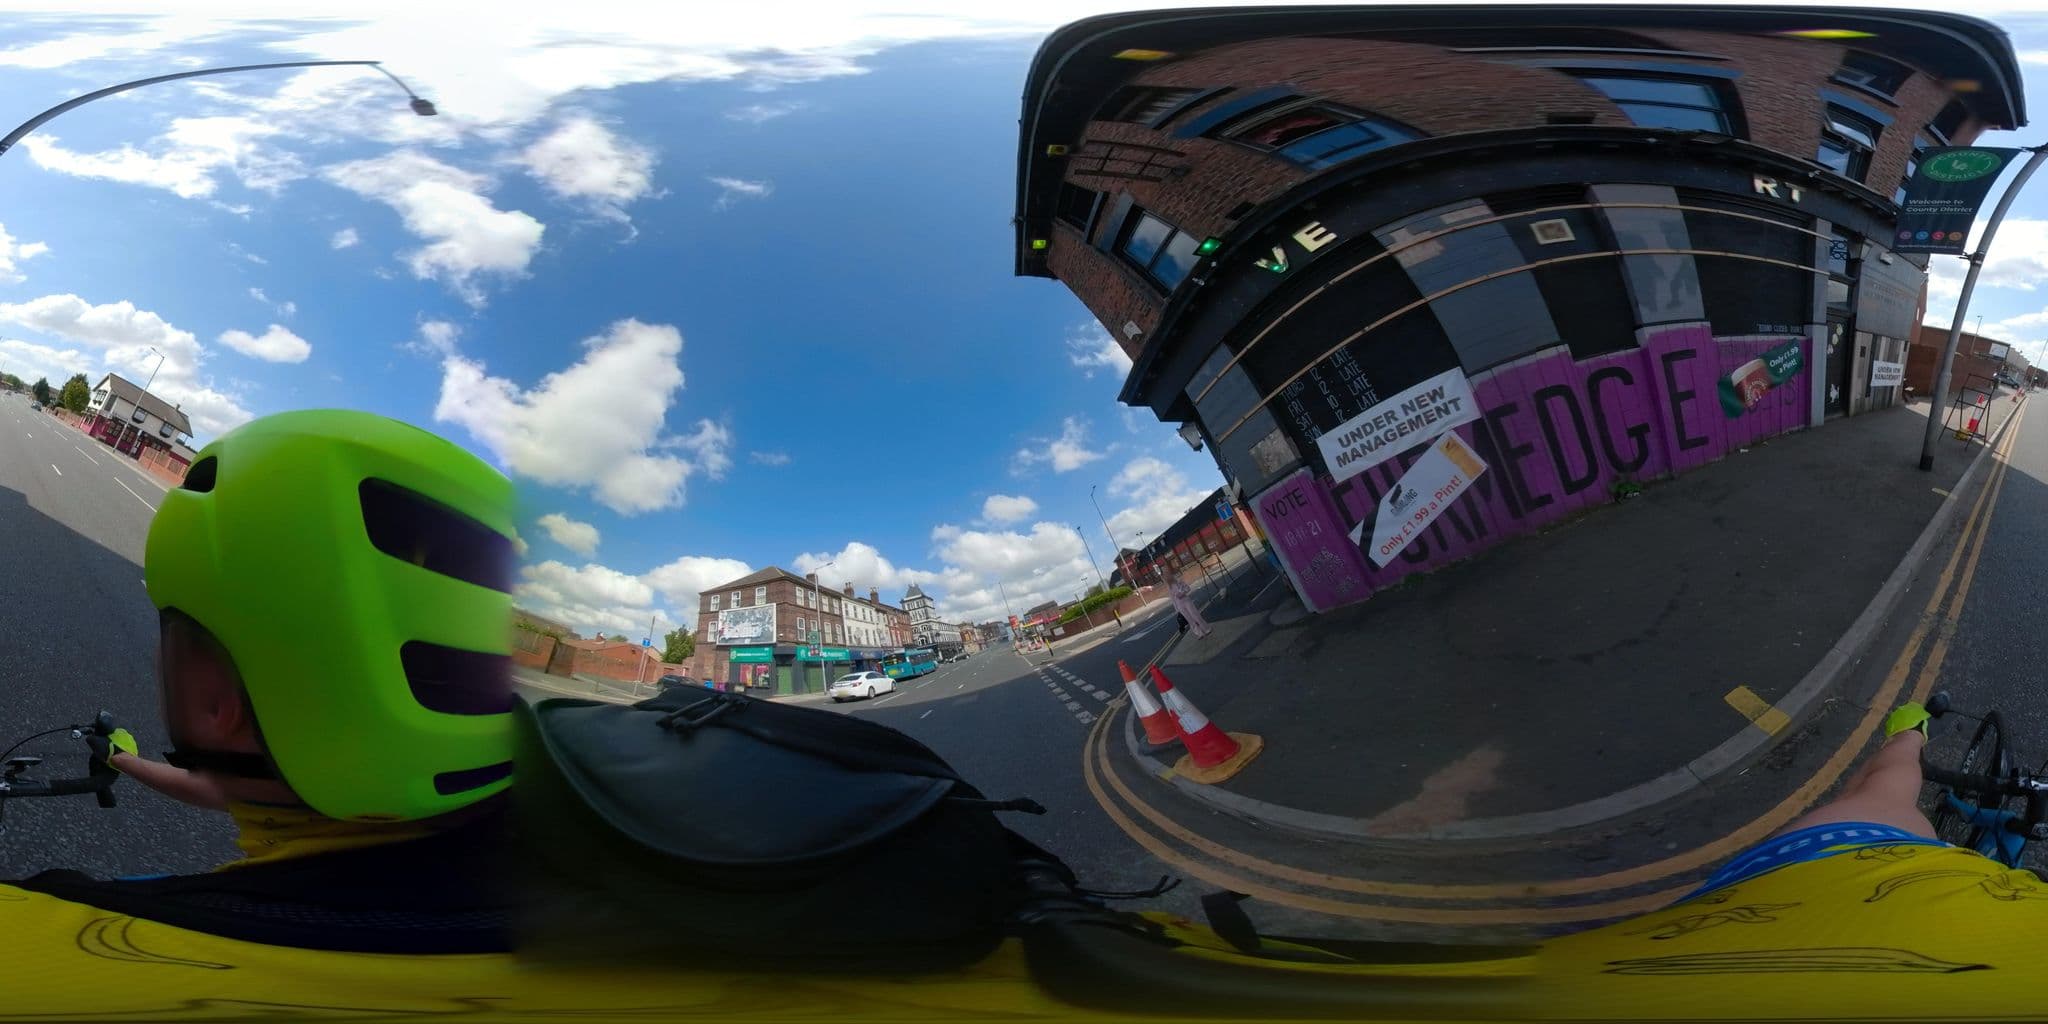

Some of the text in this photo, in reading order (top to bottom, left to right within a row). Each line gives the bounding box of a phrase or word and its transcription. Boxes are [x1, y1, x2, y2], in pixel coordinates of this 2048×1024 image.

[1330, 347, 1353, 368] LATE
[1288, 400, 1304, 418] FRI
[1338, 360, 1363, 381] LATE
[1295, 412, 1313, 431] SAT
[1348, 374, 1372, 396] LATE
[1337, 385, 1448, 449] UNDER NEW
[1355, 389, 1381, 410] LATE
[1335, 397, 1463, 468] MANAGEMENT
[1264, 487, 1308, 521] VOTE
[1380, 533, 1405, 556] Only
[1401, 507, 1430, 536] £1.99
[1430, 502, 1438, 511] a
[1434, 475, 1463, 503] Pint!
